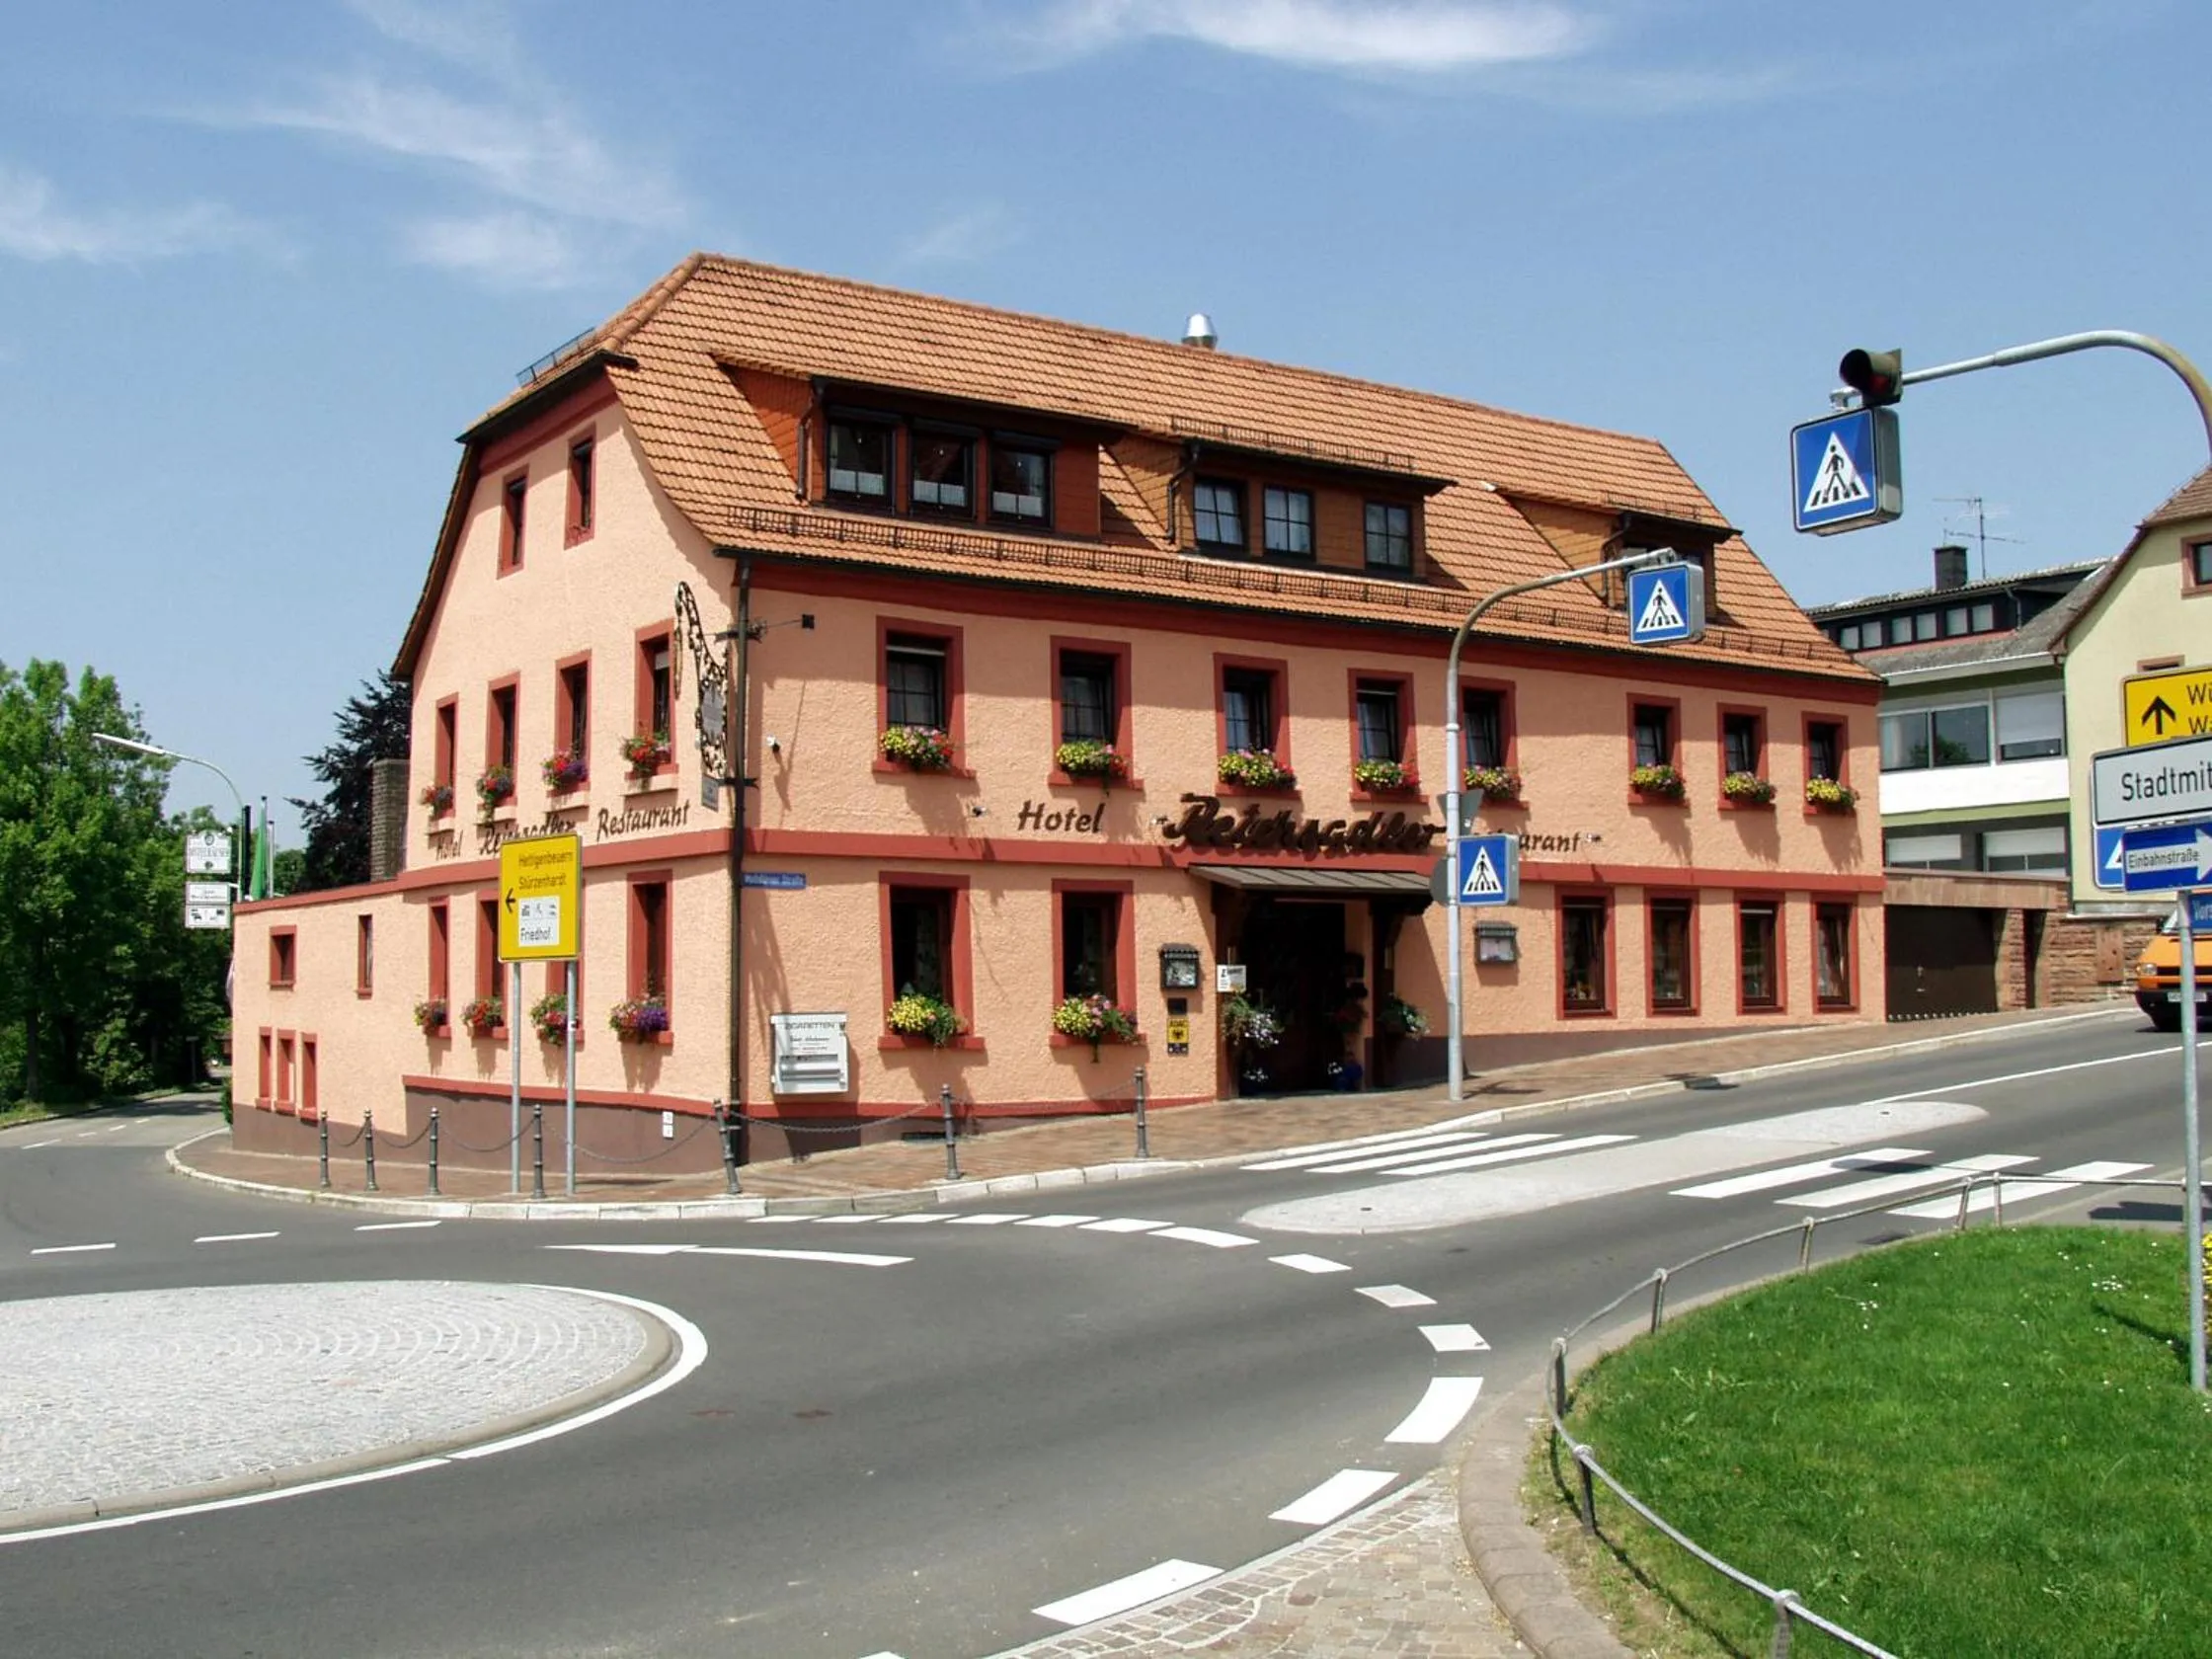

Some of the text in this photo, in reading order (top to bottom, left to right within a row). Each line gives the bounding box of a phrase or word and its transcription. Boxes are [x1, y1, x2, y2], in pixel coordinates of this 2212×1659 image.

[435, 830, 463, 860] Hotel
[596, 800, 690, 842] Restaurant
[1018, 800, 1106, 833] Hotel
[1162, 793, 1447, 852] Reichsadler
[2128, 848, 2199, 869] Einbahnstraße
[520, 927, 551, 941] Friedhof
